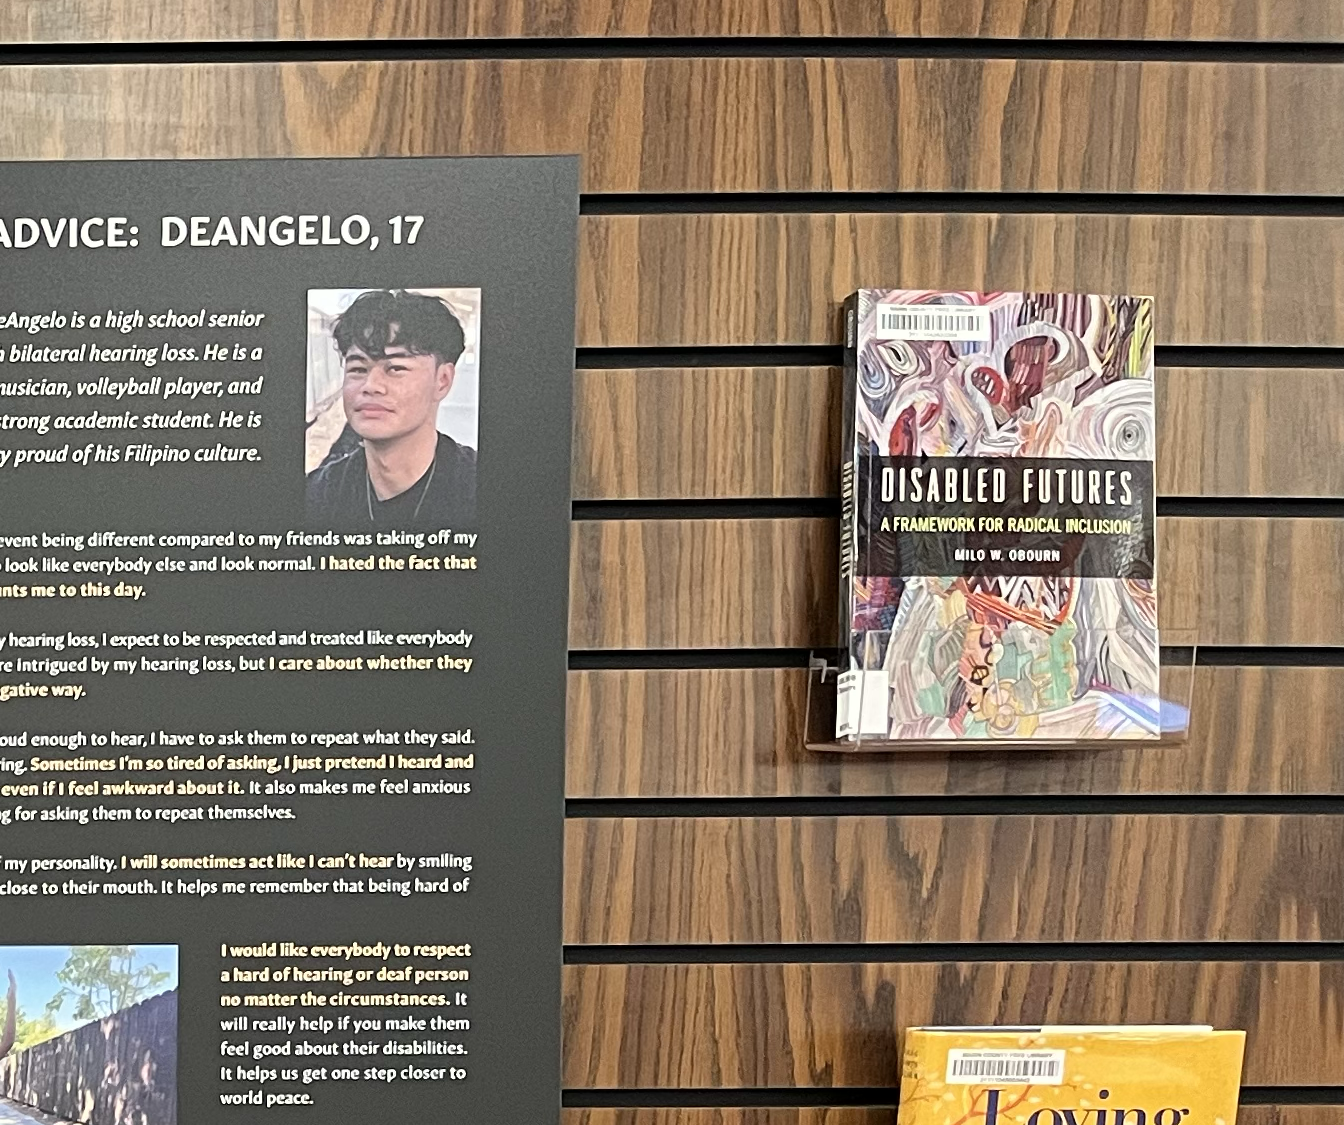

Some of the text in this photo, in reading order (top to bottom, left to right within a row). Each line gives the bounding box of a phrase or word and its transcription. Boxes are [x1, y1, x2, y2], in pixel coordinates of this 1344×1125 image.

[162, 214, 379, 251] DEANGELO,
[389, 215, 424, 244] 17
[881, 467, 1133, 506] DISABLED FUTURES
[880, 516, 1131, 535] A FRAMEWORK FOR RADICAL INCLUSION
[955, 549, 1060, 562] MILO W. OBOURN
[220, 1039, 468, 1060] feel good about their disabilities.
